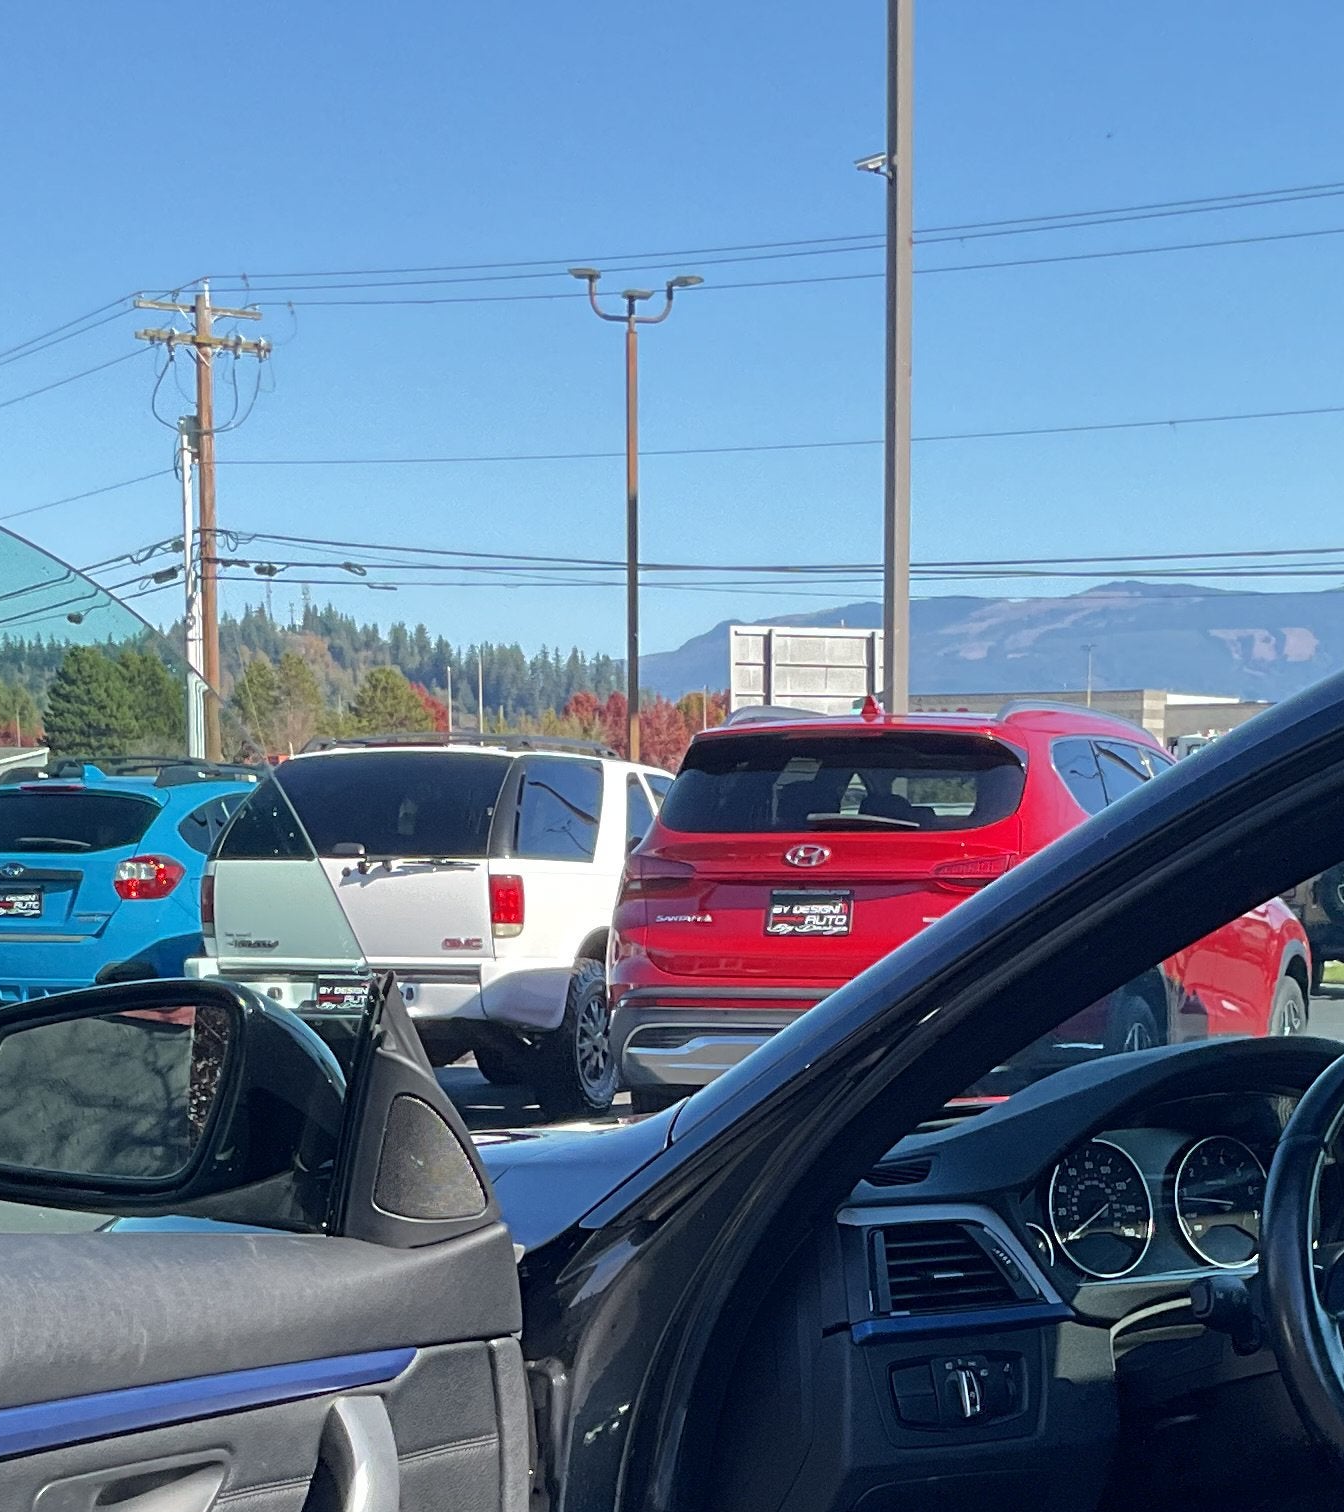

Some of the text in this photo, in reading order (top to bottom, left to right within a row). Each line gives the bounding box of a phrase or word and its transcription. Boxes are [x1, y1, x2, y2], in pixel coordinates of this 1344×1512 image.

[773, 905, 840, 913] BY DESIGN
[804, 915, 847, 925] AUTO
[441, 938, 483, 950] GMC
[319, 986, 333, 994] BY
[343, 995, 368, 1004] AUT
